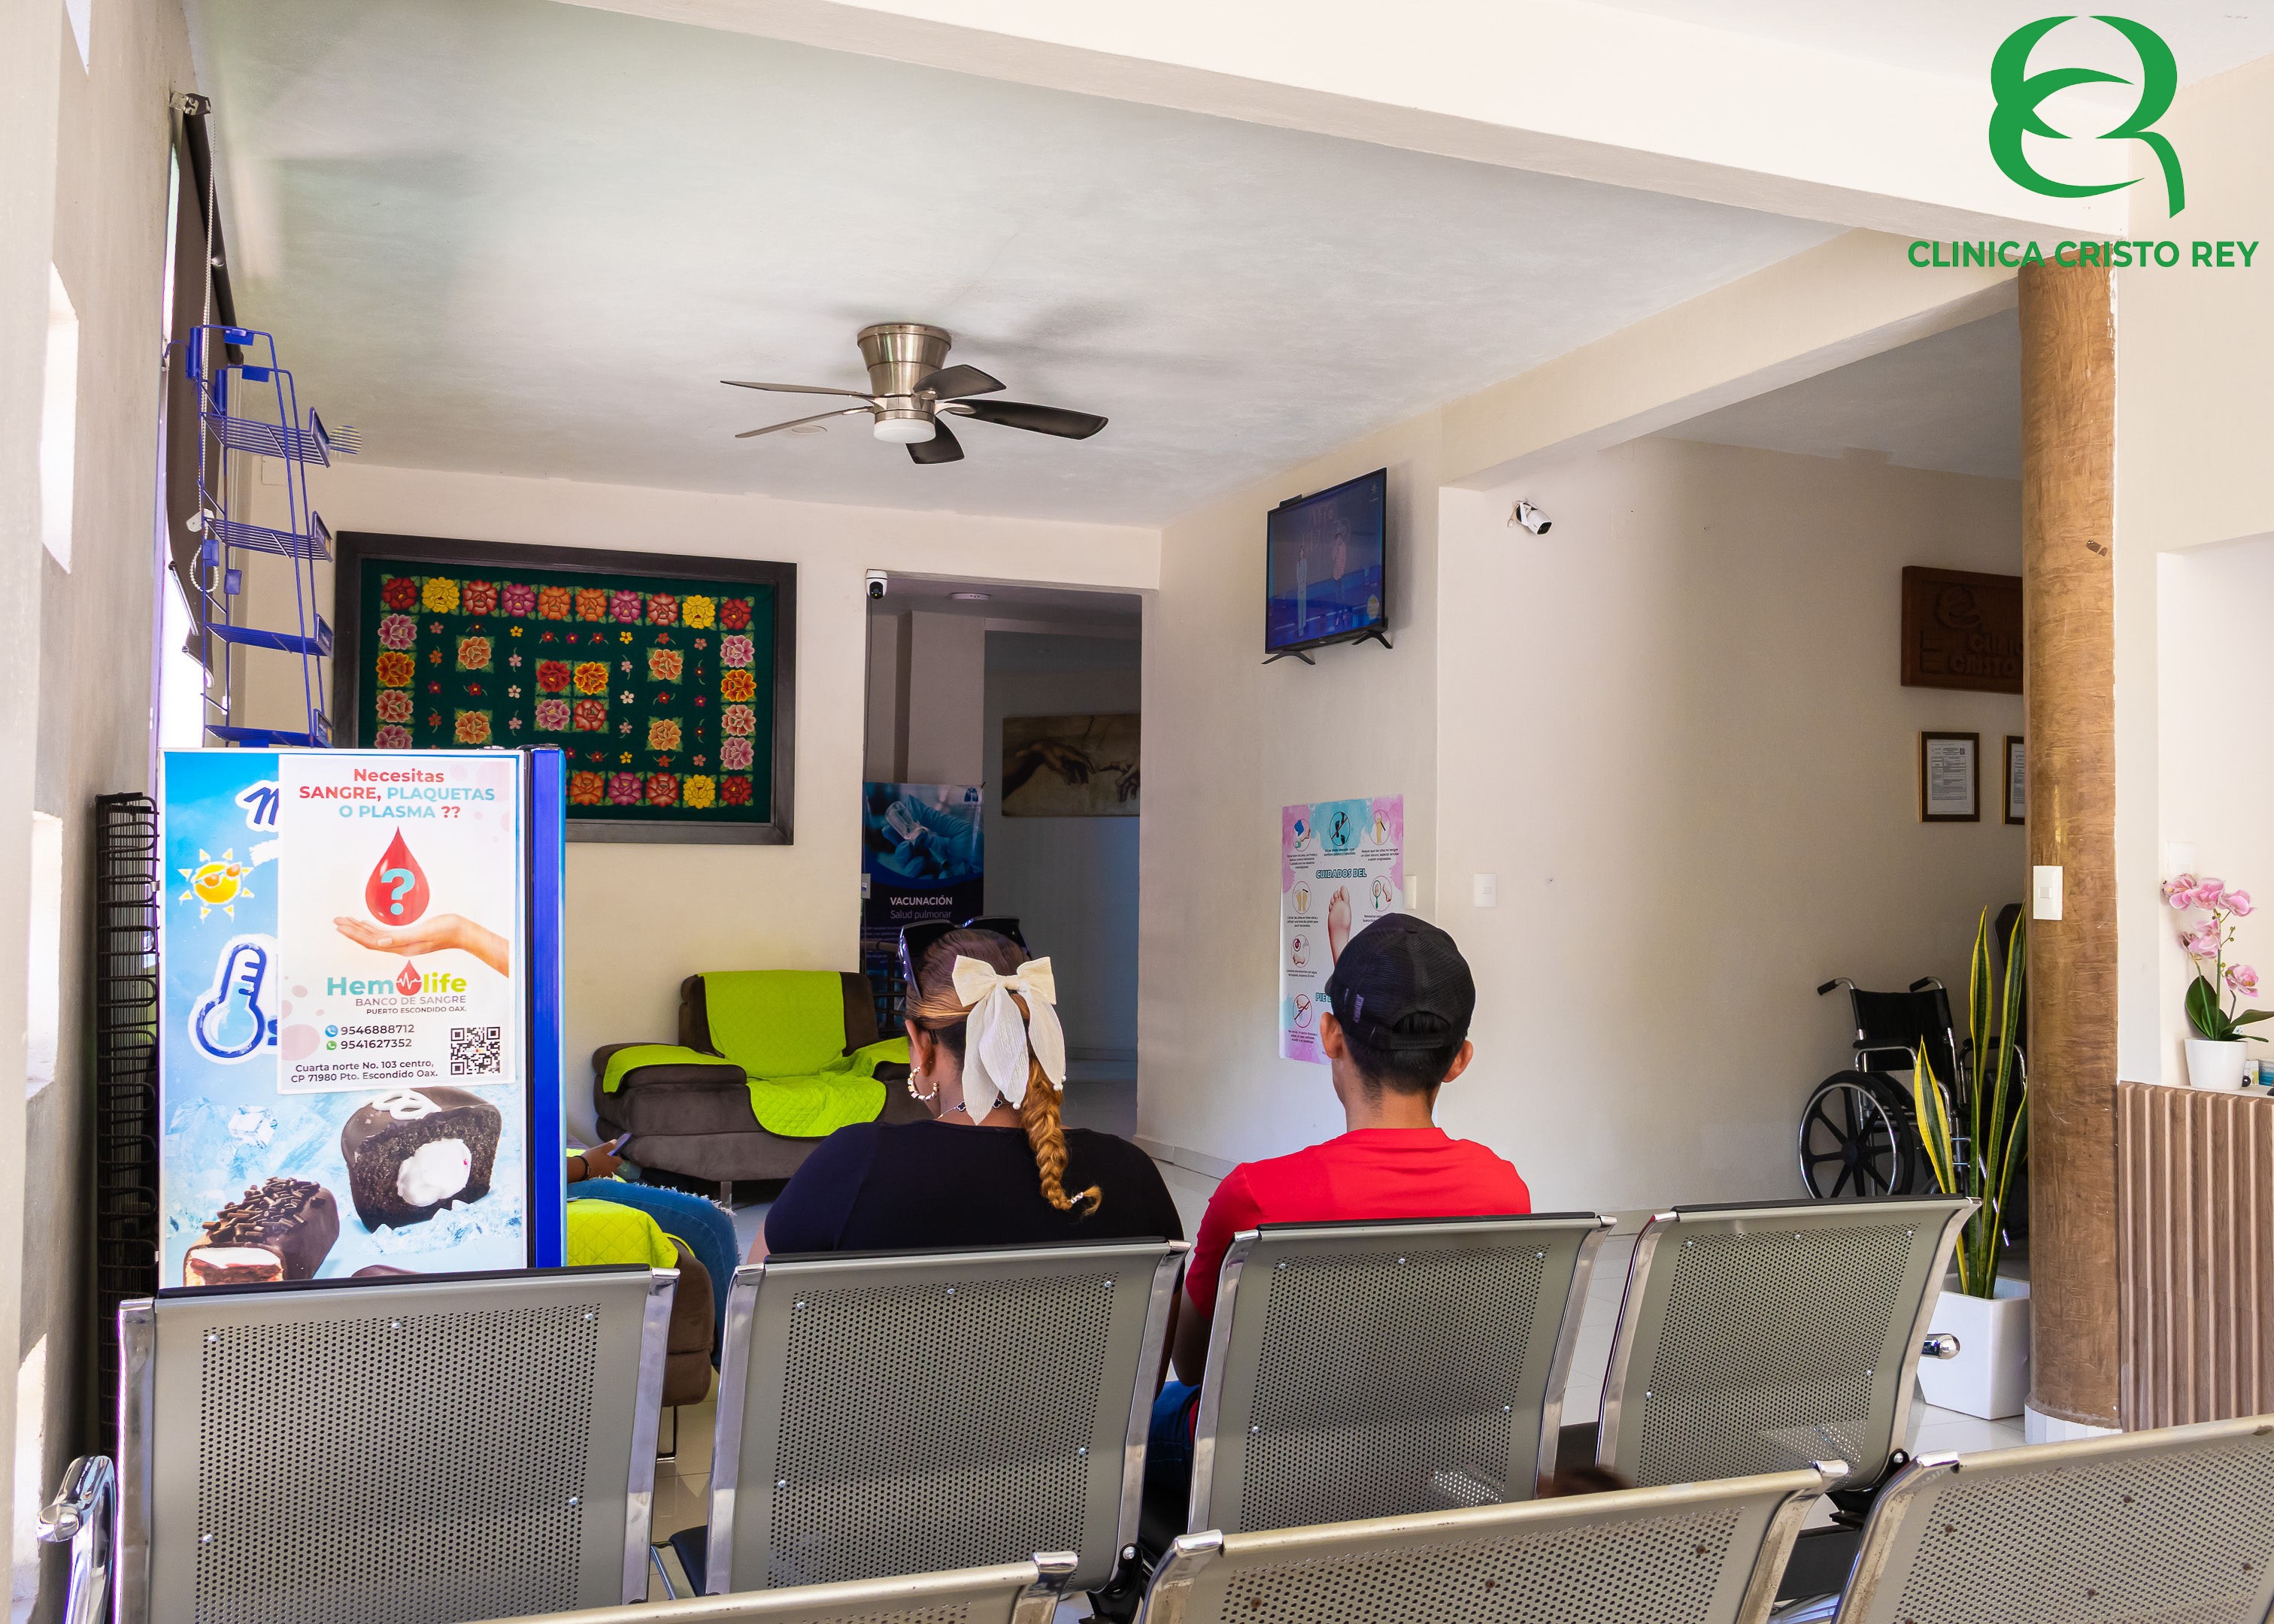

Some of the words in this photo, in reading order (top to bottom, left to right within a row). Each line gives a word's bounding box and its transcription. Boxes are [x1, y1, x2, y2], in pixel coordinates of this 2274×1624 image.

[353, 768, 444, 783] Necesitas
[299, 786, 381, 801] SANGRE,
[387, 787, 495, 802] PLAQUETAS
[339, 804, 353, 818] O
[359, 805, 435, 819] PLASMA
[441, 805, 461, 819] ??
[1316, 868, 1351, 879] CUIDADOS
[1353, 868, 1367, 878] DEL
[890, 895, 953, 905] VACUNACIÓN
[890, 910, 912, 919] Salud
[914, 910, 951, 920] pulmonar
[356, 998, 397, 1006] BANCO
[401, 997, 416, 1005] DE
[420, 995, 466, 1004] SANGRE
[1316, 992, 1326, 1001] PIE
[341, 1025, 415, 1035] 9546888712
[341, 1038, 413, 1050] 9541627352
[399, 1060, 434, 1068] centro,
[308, 1074, 337, 1082] 71980
[362, 1070, 414, 1080] Escondido
